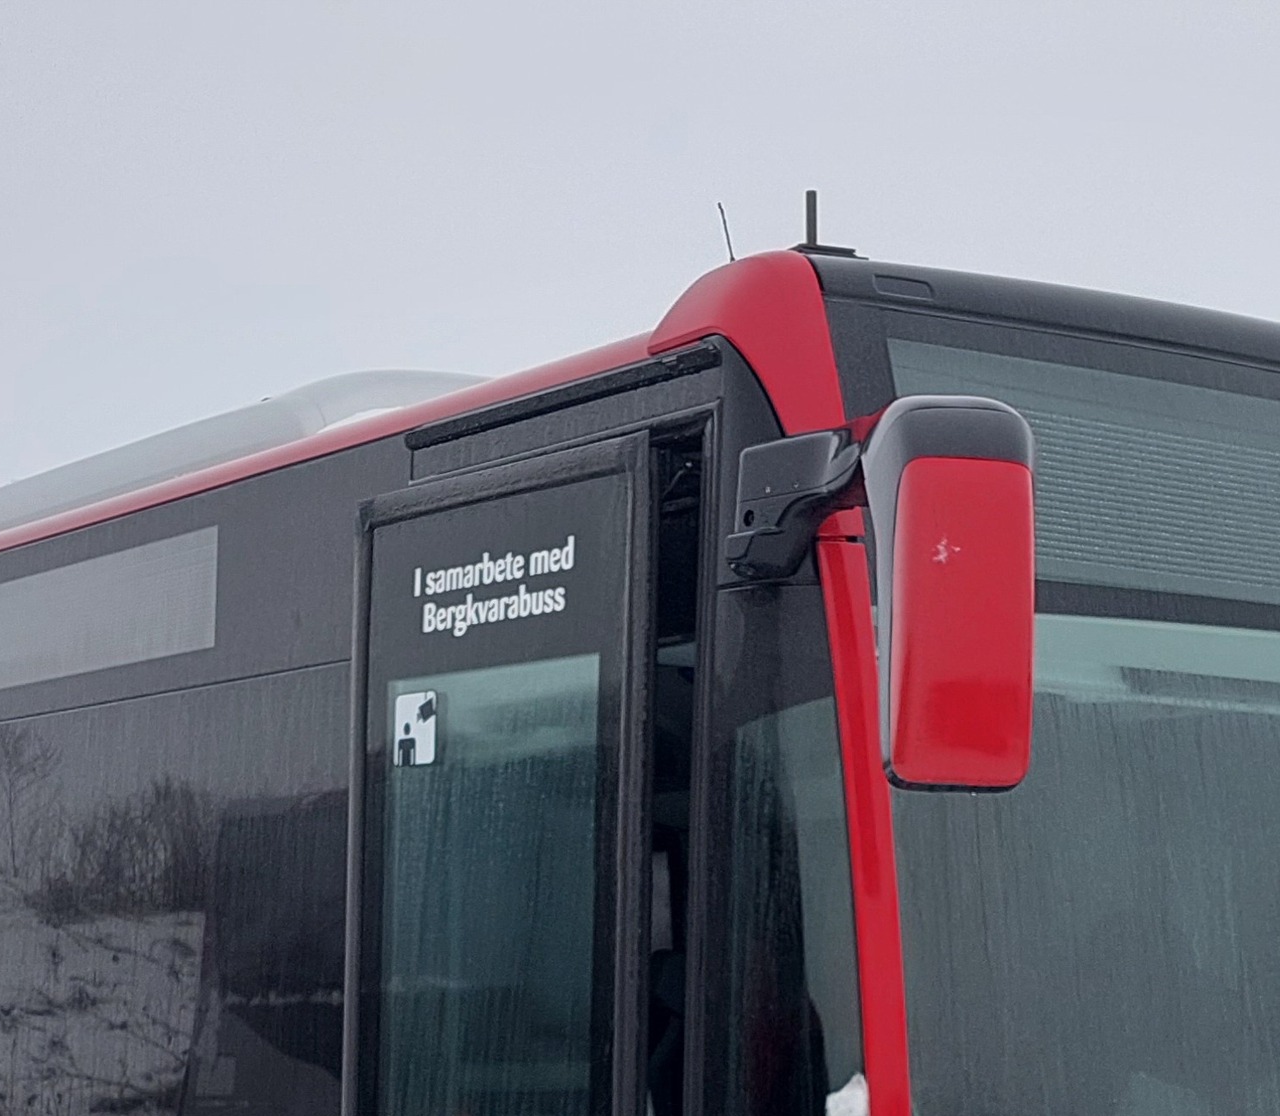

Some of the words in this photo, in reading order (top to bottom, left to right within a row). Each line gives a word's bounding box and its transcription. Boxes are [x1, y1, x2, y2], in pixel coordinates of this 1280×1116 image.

[414, 568, 422, 597] I
[425, 552, 525, 596] samarbete
[529, 535, 575, 577] med
[423, 585, 566, 637] Bergkvarabuss
